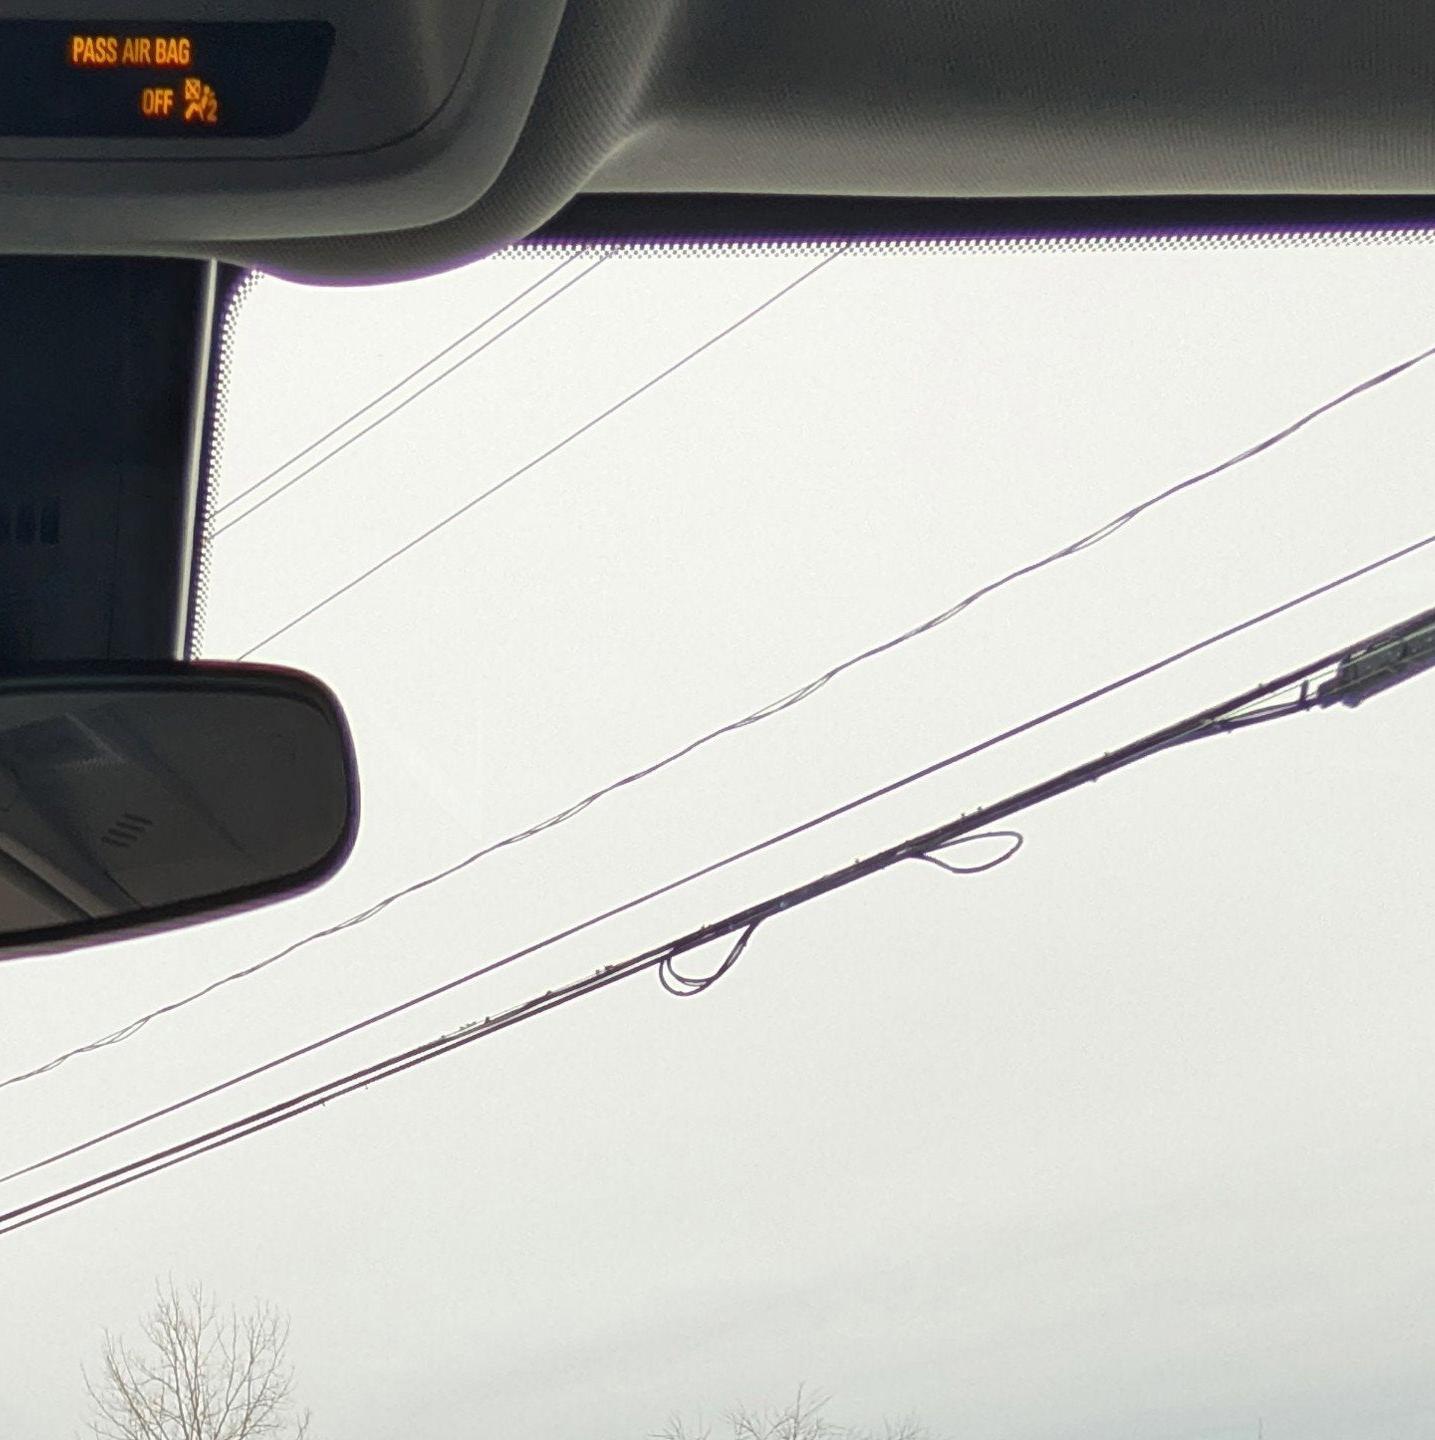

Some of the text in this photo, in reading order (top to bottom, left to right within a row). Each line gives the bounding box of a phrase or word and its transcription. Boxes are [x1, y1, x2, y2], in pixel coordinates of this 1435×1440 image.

[72, 37, 190, 65] PASS AIR BAG
[142, 88, 173, 115] OFF
